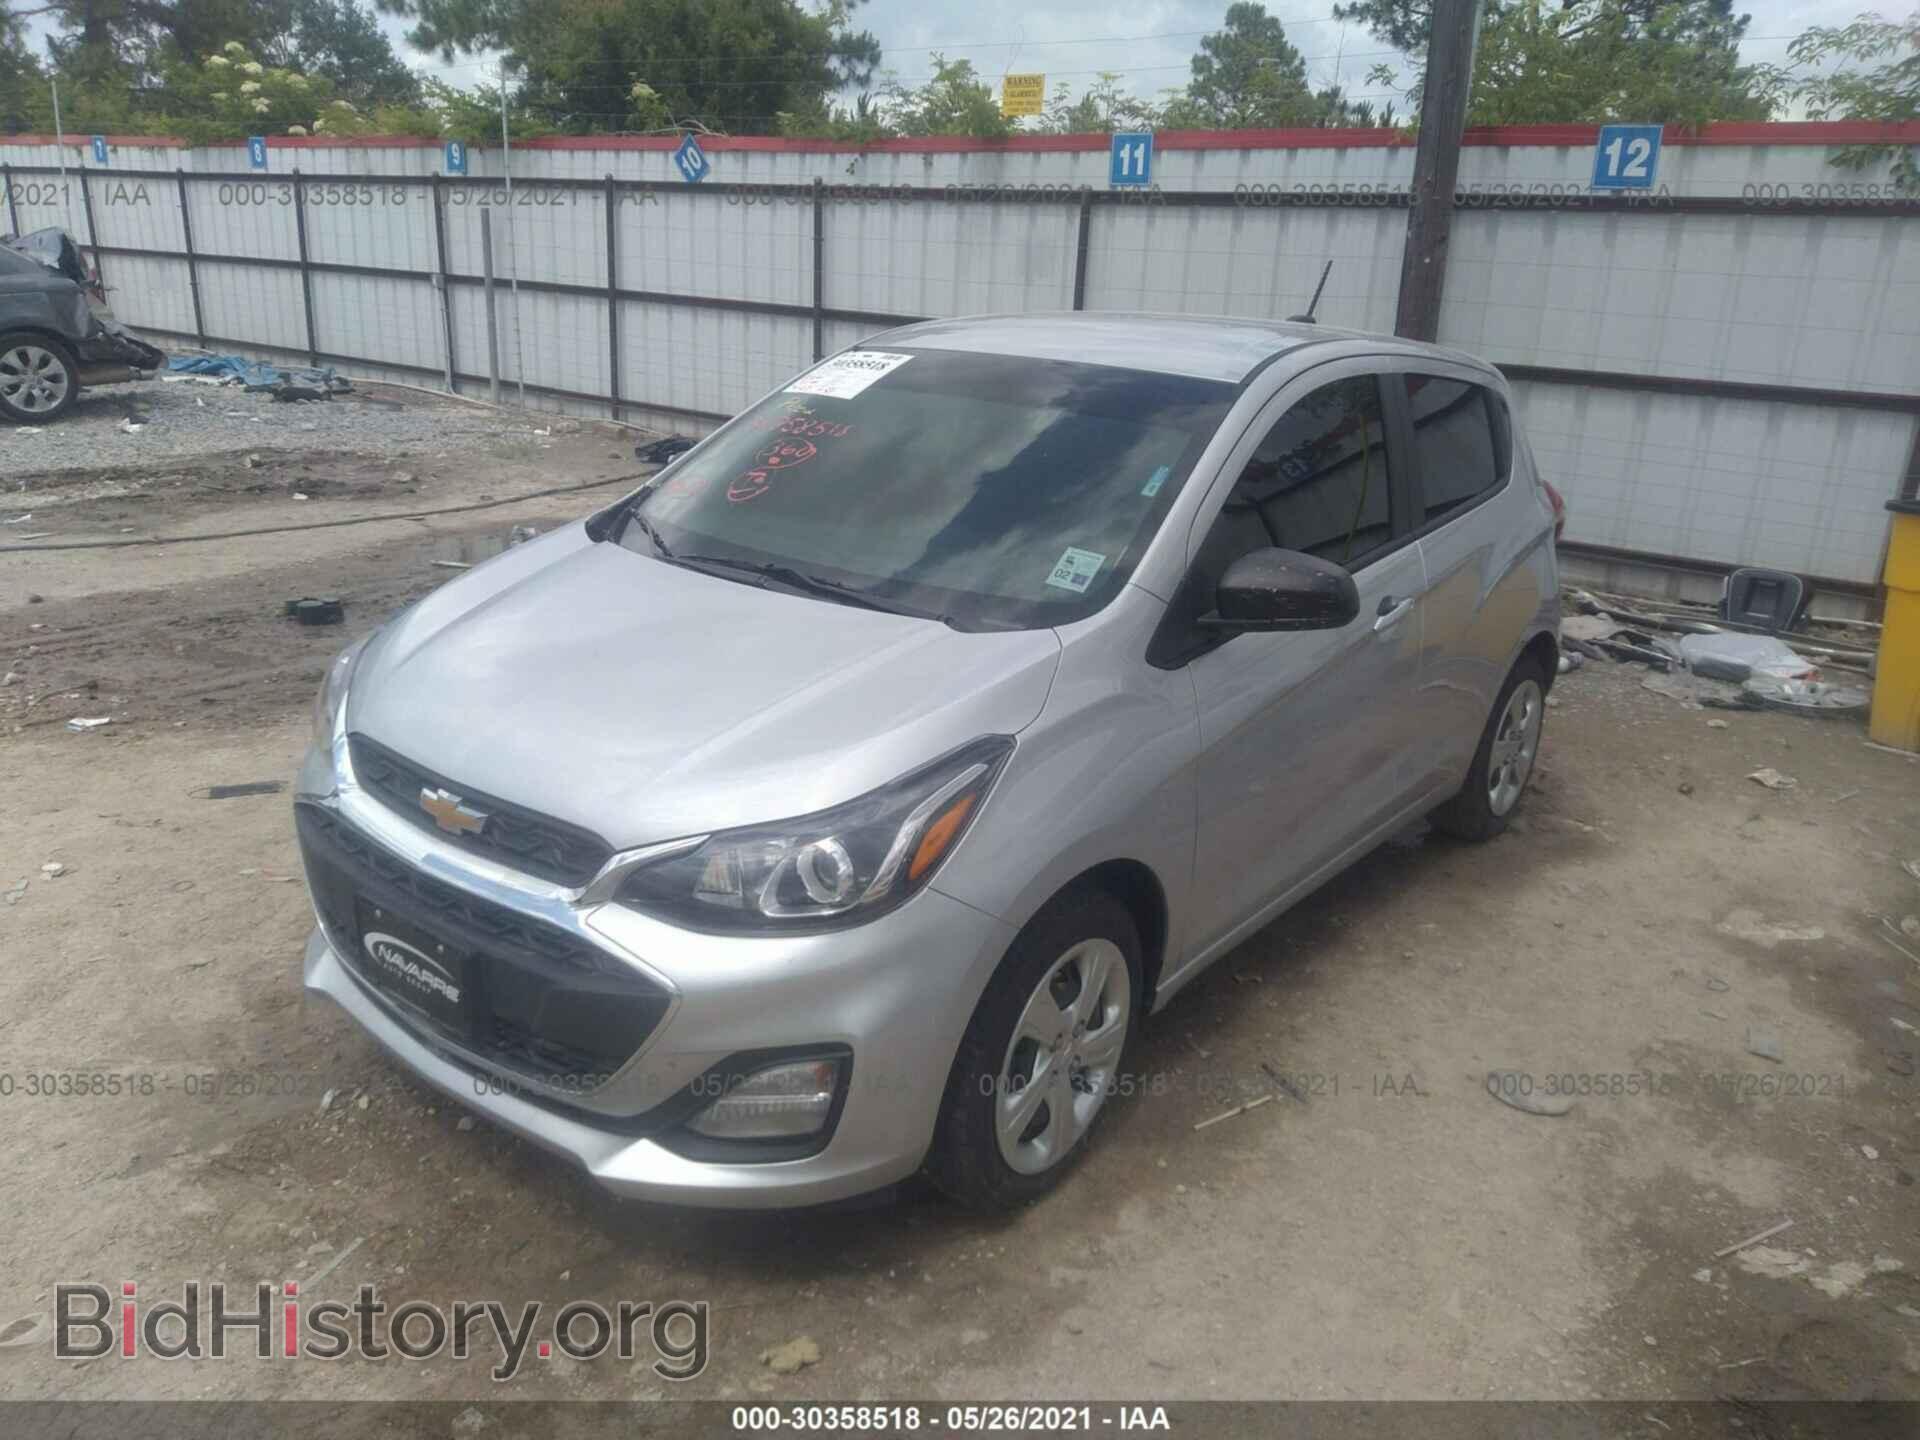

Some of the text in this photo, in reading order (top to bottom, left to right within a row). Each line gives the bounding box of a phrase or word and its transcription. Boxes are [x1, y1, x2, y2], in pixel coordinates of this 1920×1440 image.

[253, 142, 263, 163] 8
[450, 142, 461, 166] 9
[682, 148, 701, 176] 10
[1119, 143, 1145, 176] 11
[1604, 136, 1650, 177] 12
[378, 943, 460, 1003] NAVARRE
